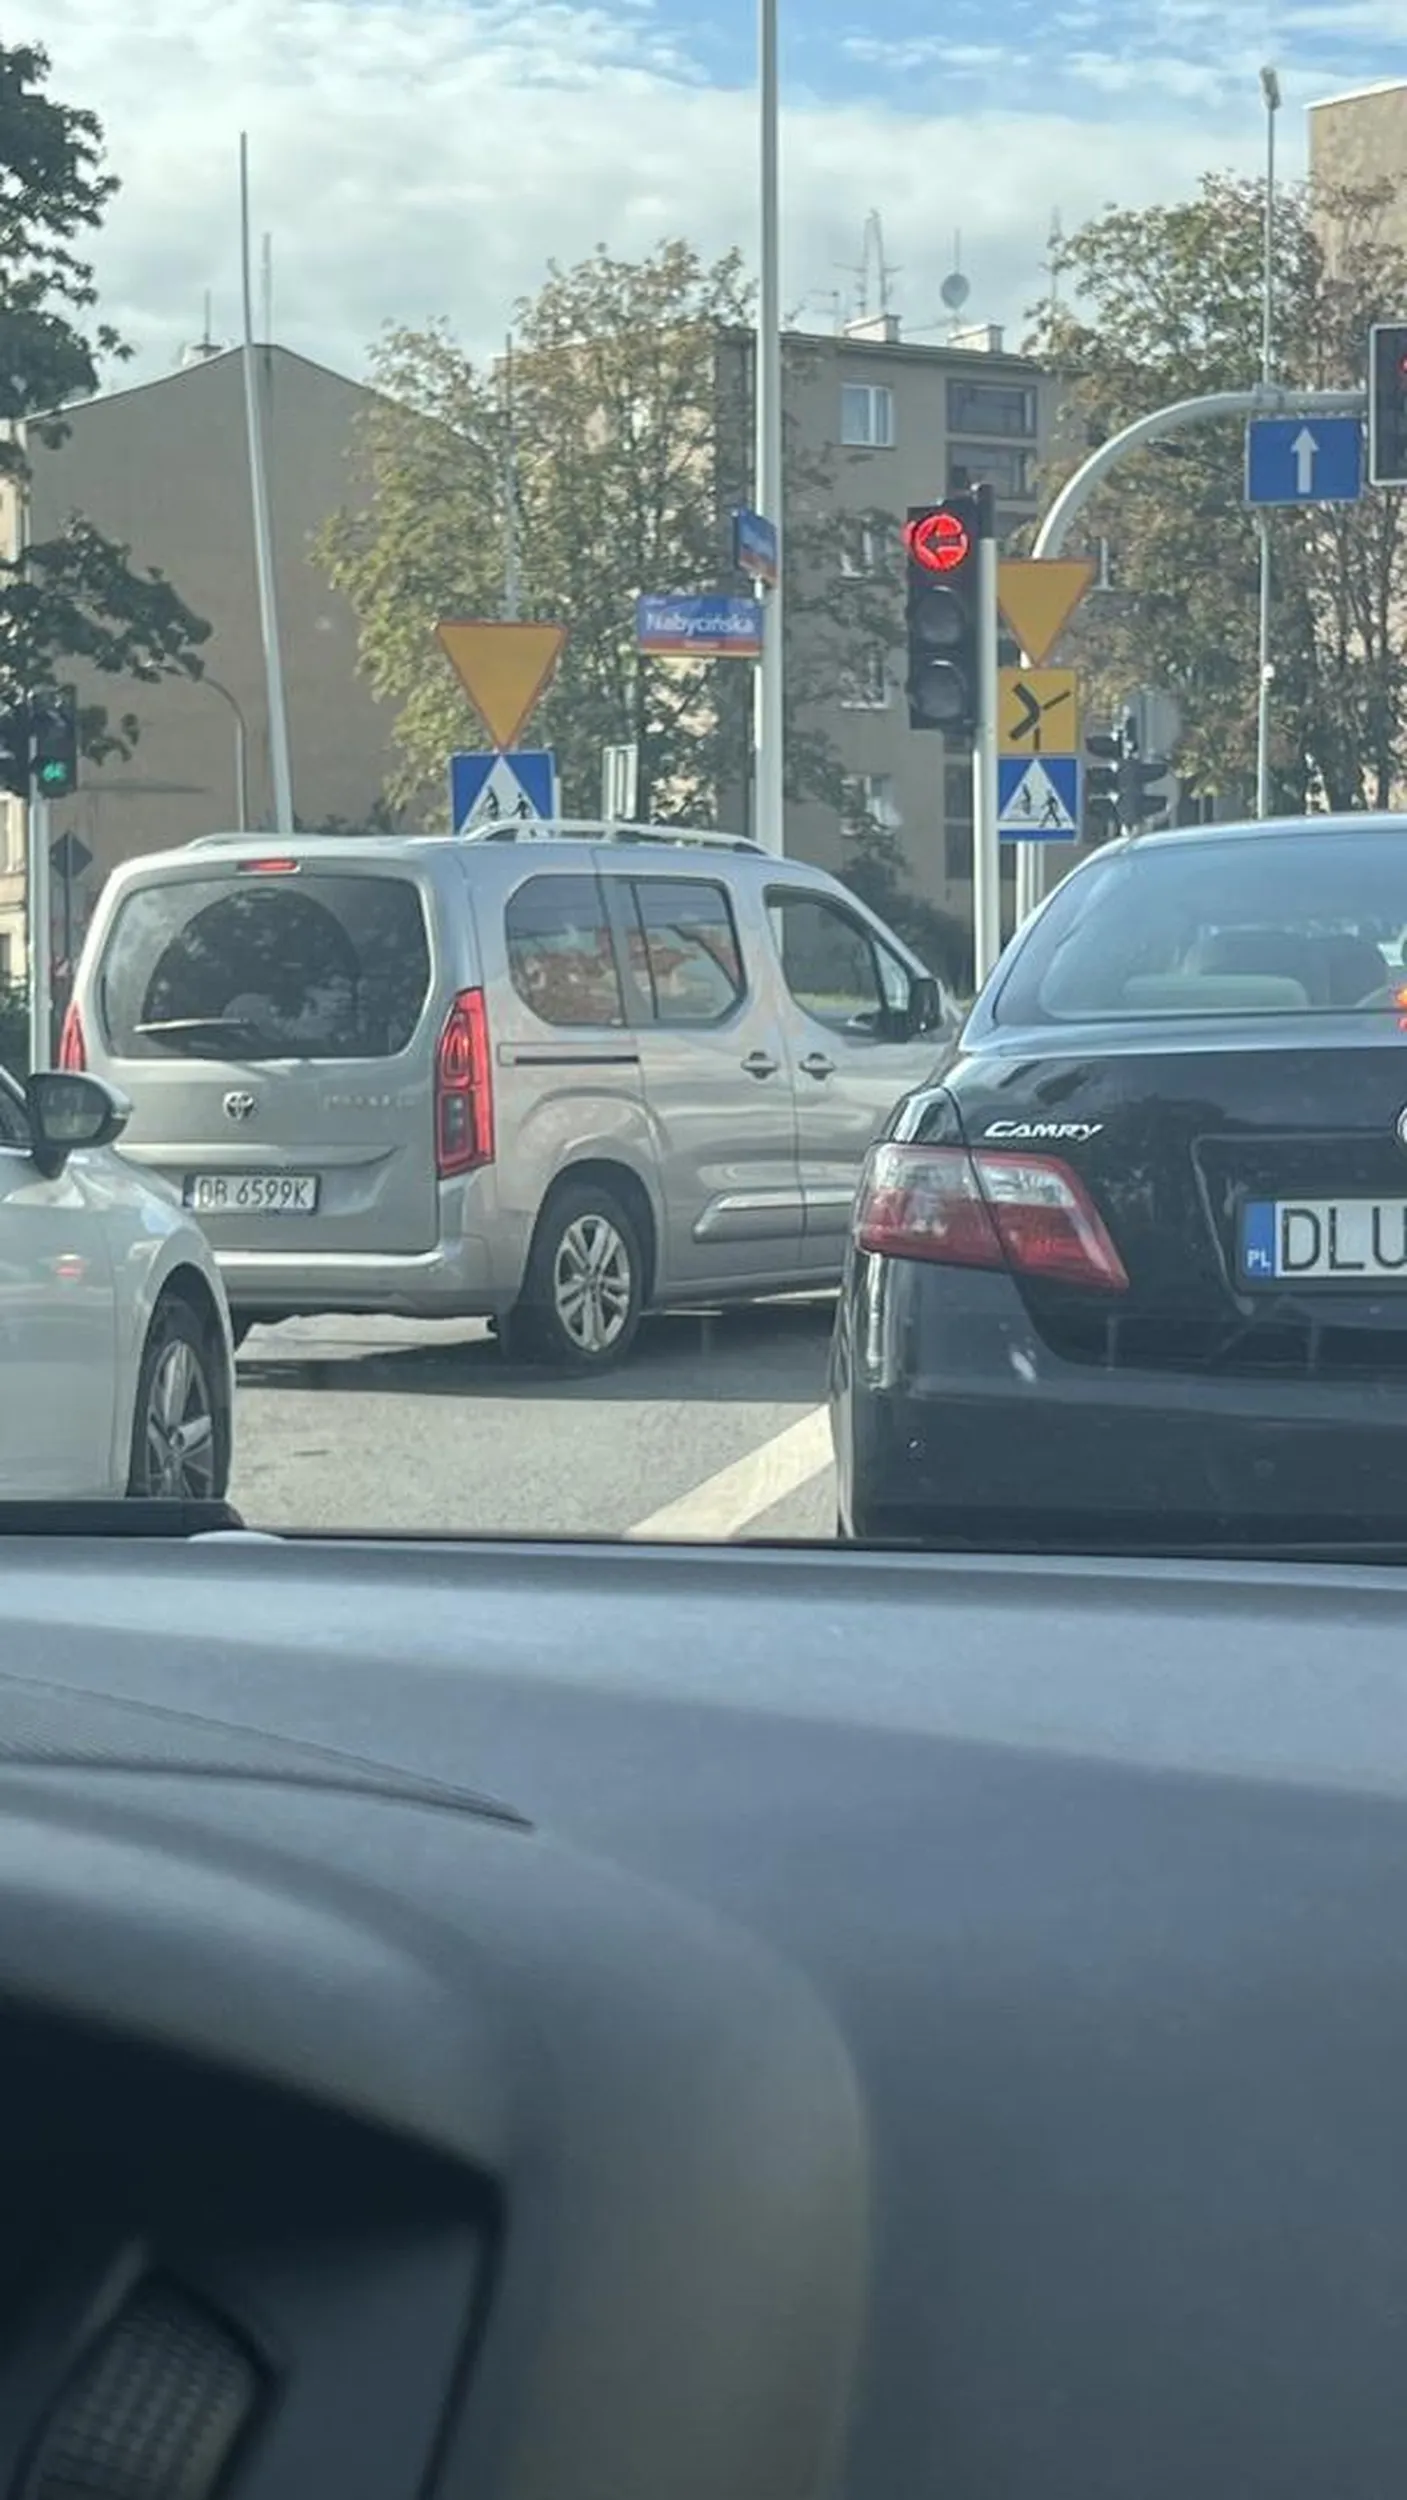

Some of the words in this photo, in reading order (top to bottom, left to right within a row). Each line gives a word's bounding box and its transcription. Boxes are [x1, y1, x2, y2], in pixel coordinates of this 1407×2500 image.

[646, 611, 755, 637] Nabycińska
[984, 1121, 1103, 1142] CAMRY
[236, 1179, 308, 1207] 6599K
[1282, 1206, 1407, 1272] DLU
[1247, 1249, 1272, 1272] PL
